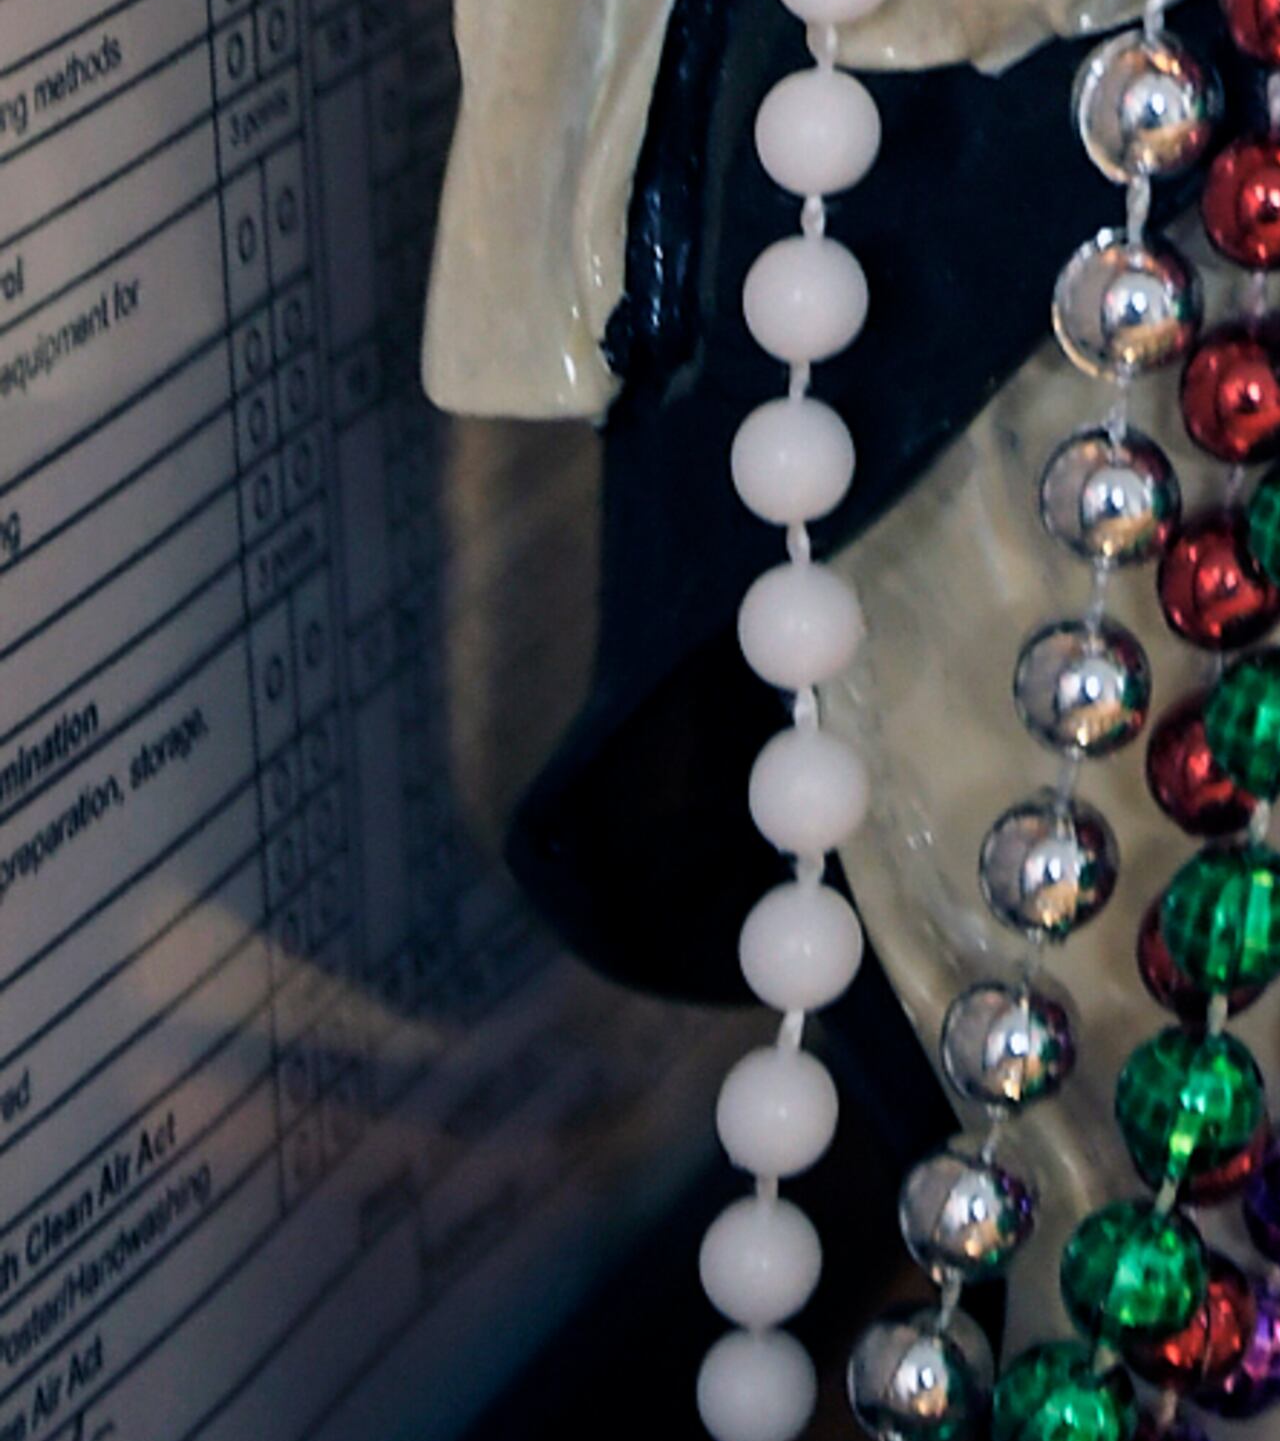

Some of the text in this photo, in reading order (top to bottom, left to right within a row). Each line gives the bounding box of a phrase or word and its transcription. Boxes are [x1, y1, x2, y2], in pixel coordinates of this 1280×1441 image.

[34, 32, 123, 112] methods
[112, 277, 140, 322] for
[26, 1188, 93, 1268] Clean
[98, 1152, 131, 1208] Air
[137, 1110, 175, 1174] Act
[31, 1332, 103, 1434] Air Act
